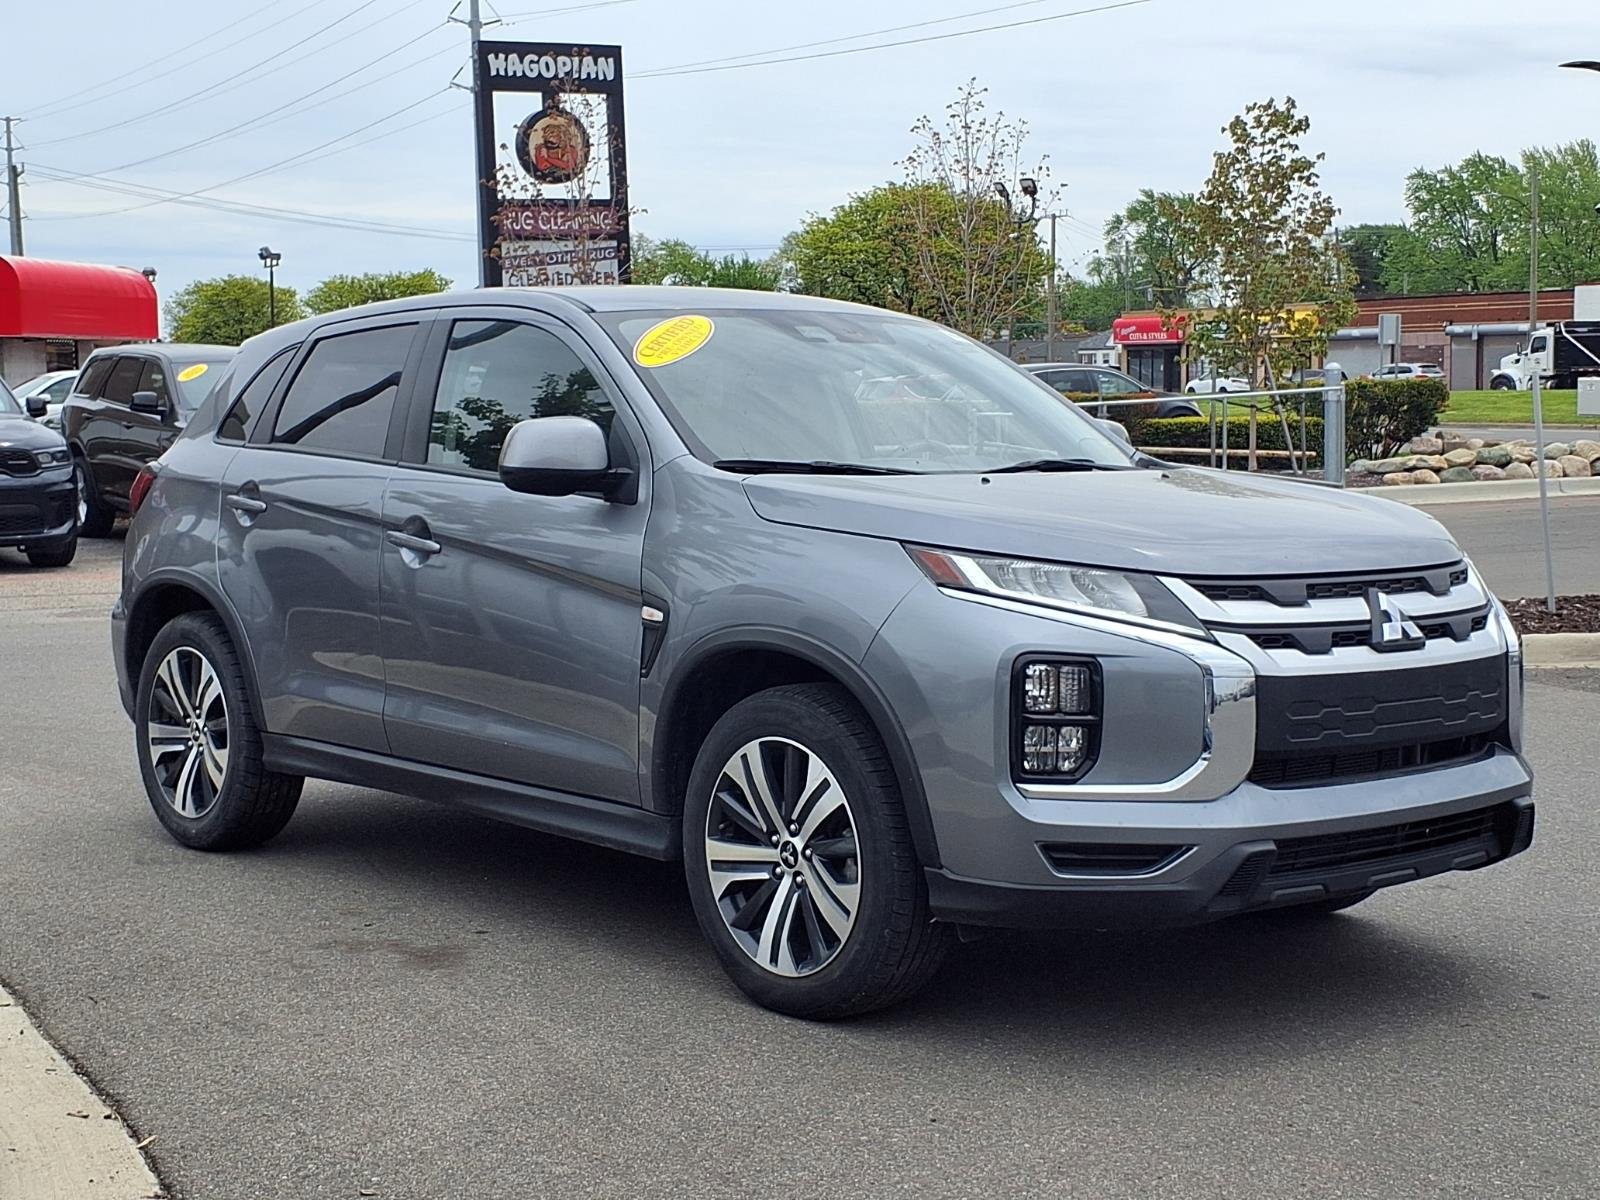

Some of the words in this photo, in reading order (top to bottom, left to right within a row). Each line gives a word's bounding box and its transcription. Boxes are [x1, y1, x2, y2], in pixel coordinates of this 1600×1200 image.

[487, 52, 615, 81] HAGOPIAN
[503, 211, 533, 230] RUG
[546, 250, 587, 264] OTHE
[589, 248, 616, 260] RUG
[639, 318, 695, 357] CERTIFIED
[1129, 332, 1142, 341] CUTS
[1148, 332, 1168, 340] STYLES
